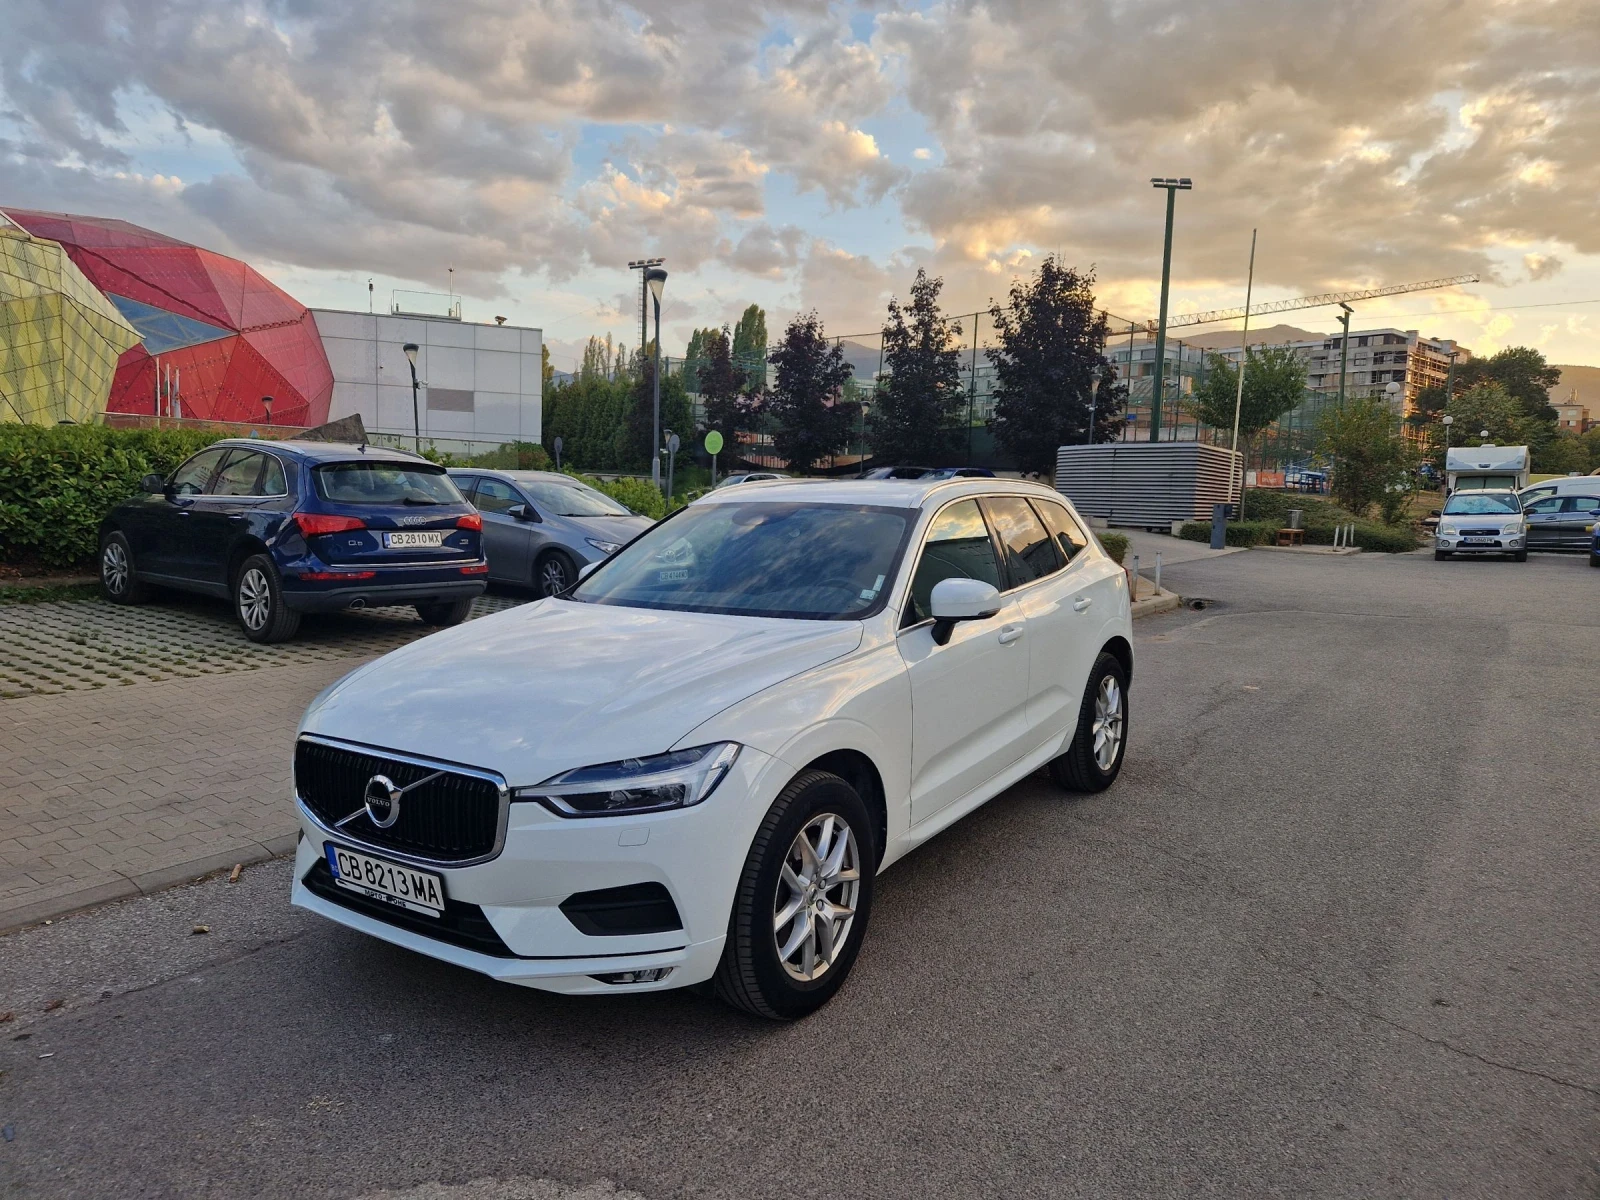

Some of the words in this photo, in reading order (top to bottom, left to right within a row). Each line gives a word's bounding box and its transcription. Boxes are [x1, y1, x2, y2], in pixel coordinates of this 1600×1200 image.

[391, 534, 404, 544] CB
[406, 534, 427, 544] 2810
[428, 533, 440, 544] MX
[367, 796, 390, 807] VOLVO
[338, 852, 363, 881] CB
[365, 860, 410, 896] 8213
[411, 873, 441, 906] MA
